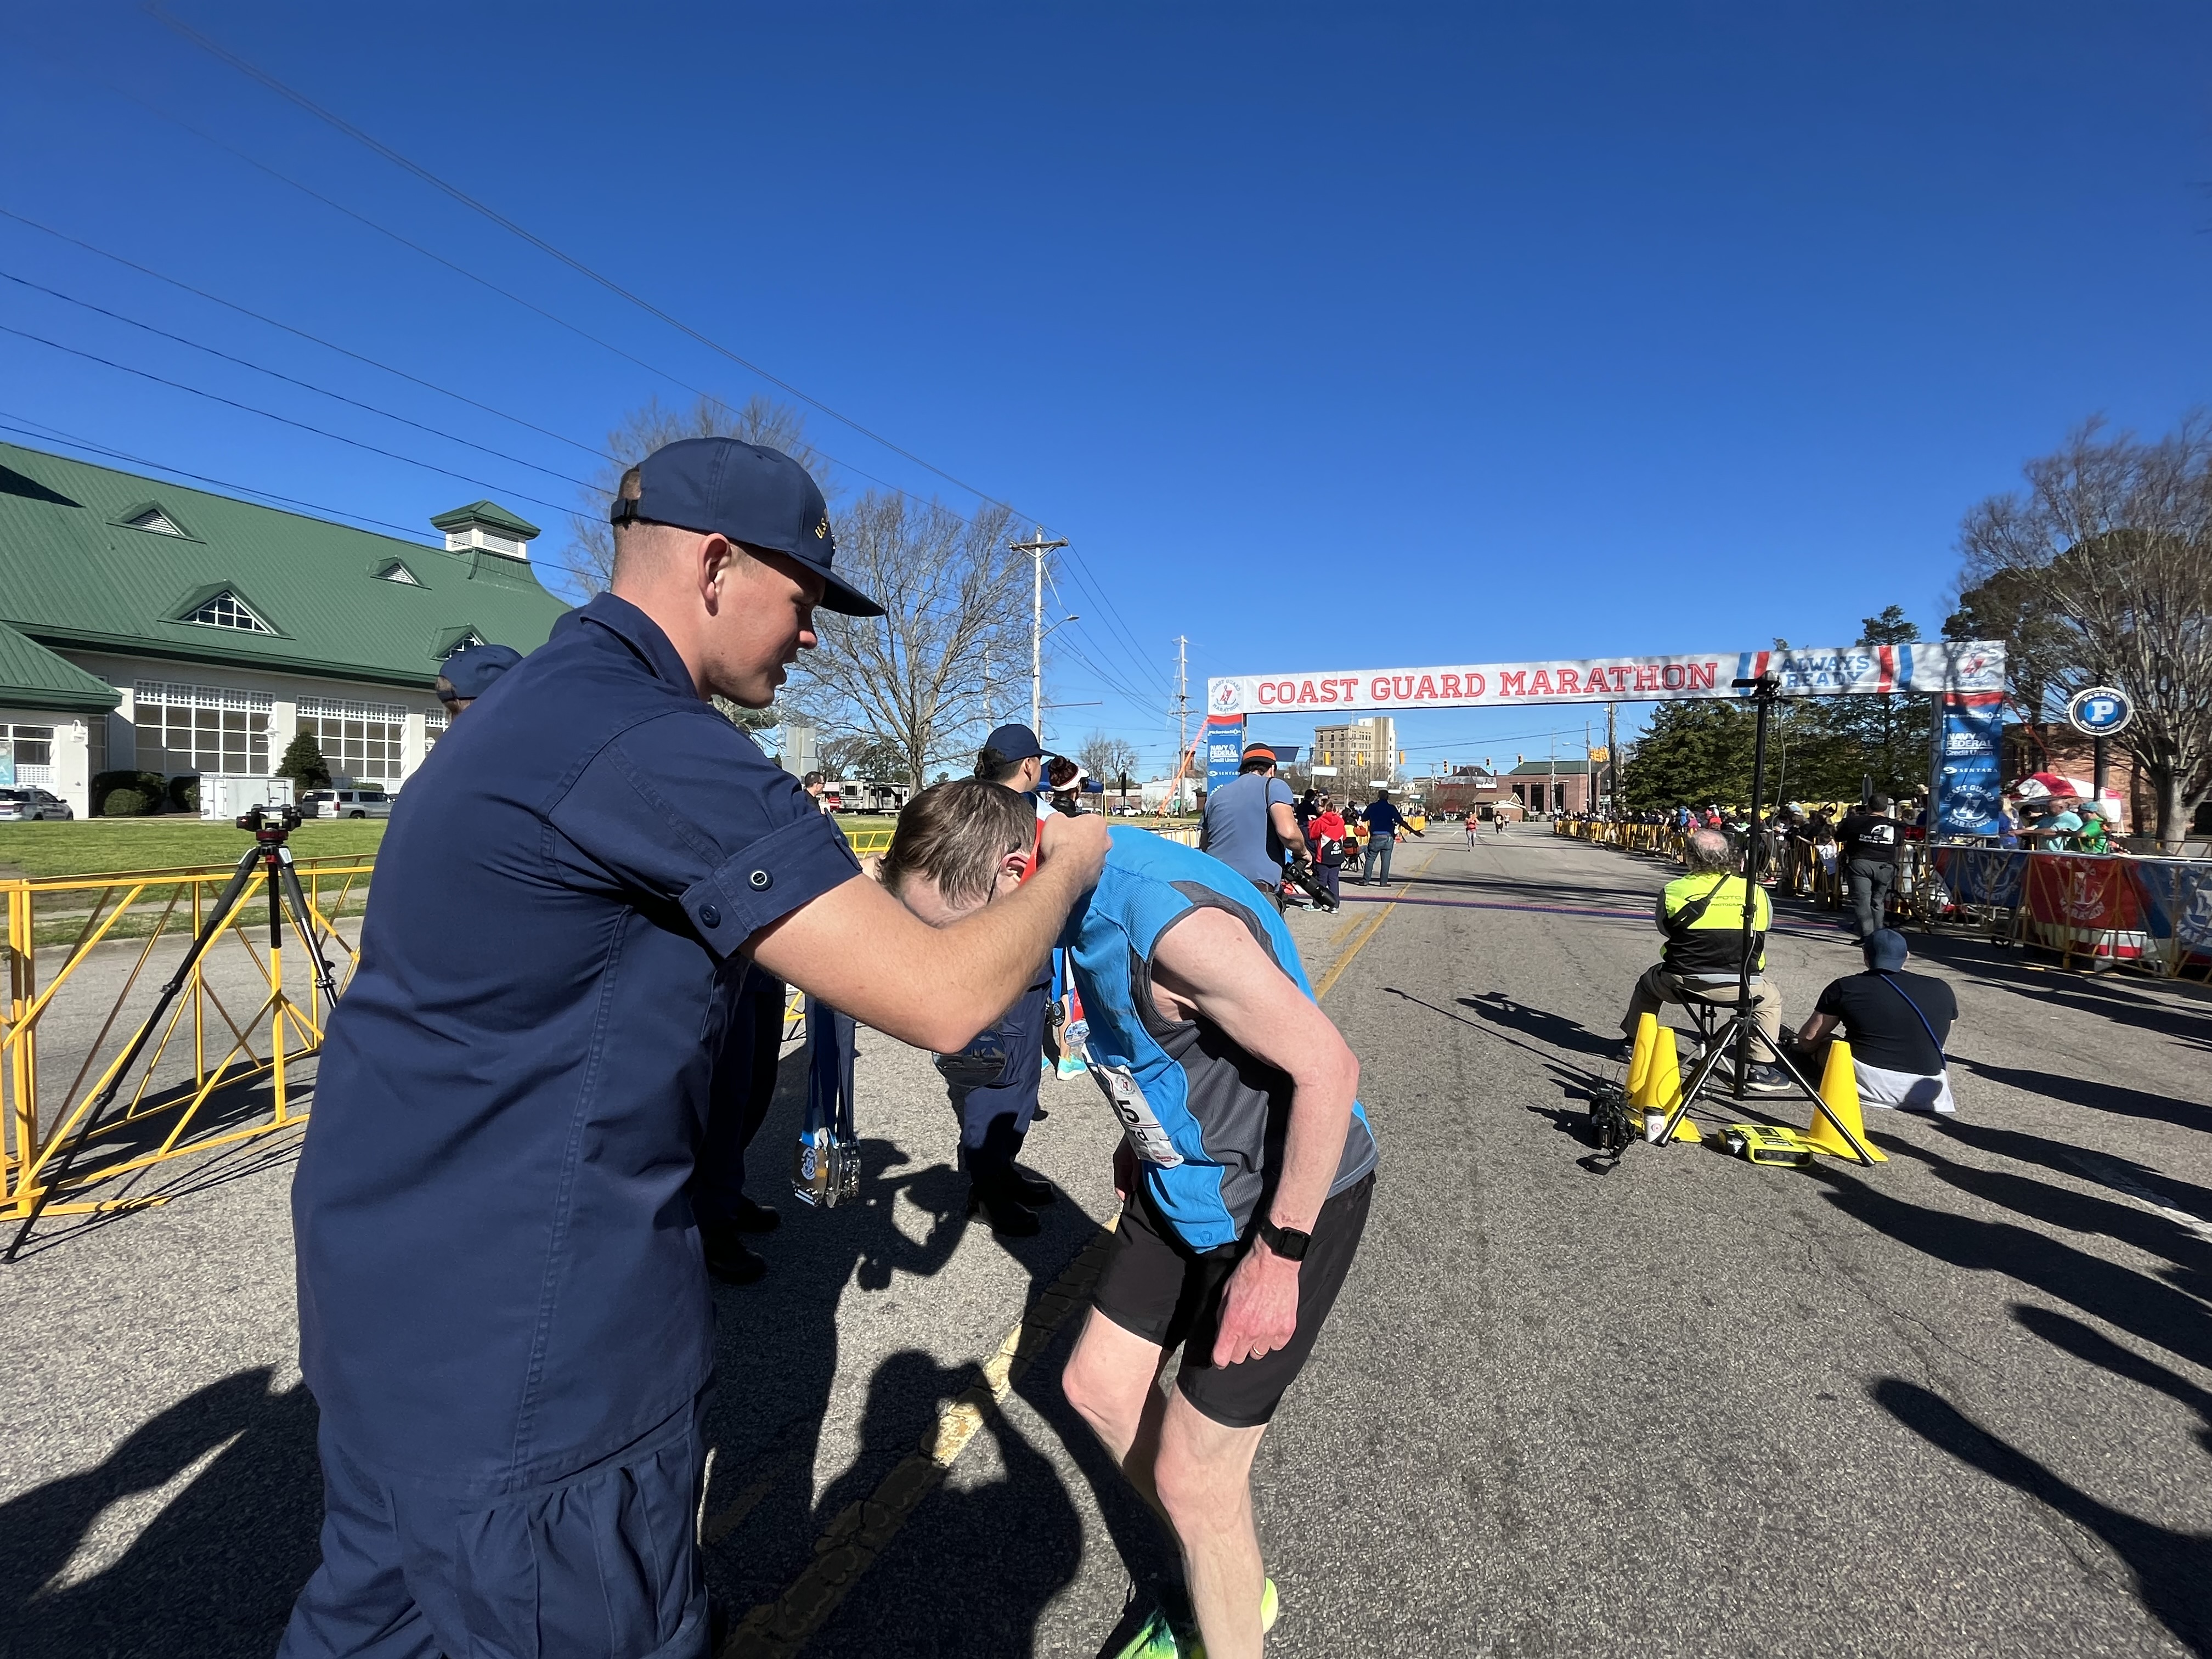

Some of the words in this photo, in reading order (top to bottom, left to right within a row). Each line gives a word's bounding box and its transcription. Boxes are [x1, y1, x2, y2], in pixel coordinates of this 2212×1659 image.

[1780, 655, 1870, 672] ALWAYS
[1211, 680, 1224, 693] COAST
[1226, 680, 1240, 692] GUARD
[1259, 678, 1358, 704] COAST
[1372, 673, 1485, 701] GUARD
[1499, 663, 1718, 696] MARATHON
[1786, 672, 1864, 687] READY
[2083, 692, 2121, 702] PARKING
[1212, 702, 1239, 712] MARATHON
[2091, 701, 2114, 721] P
[1945, 785, 1967, 802] COAST
[1970, 785, 1995, 802] GUARD
[1948, 816, 1993, 828] MARATHON
